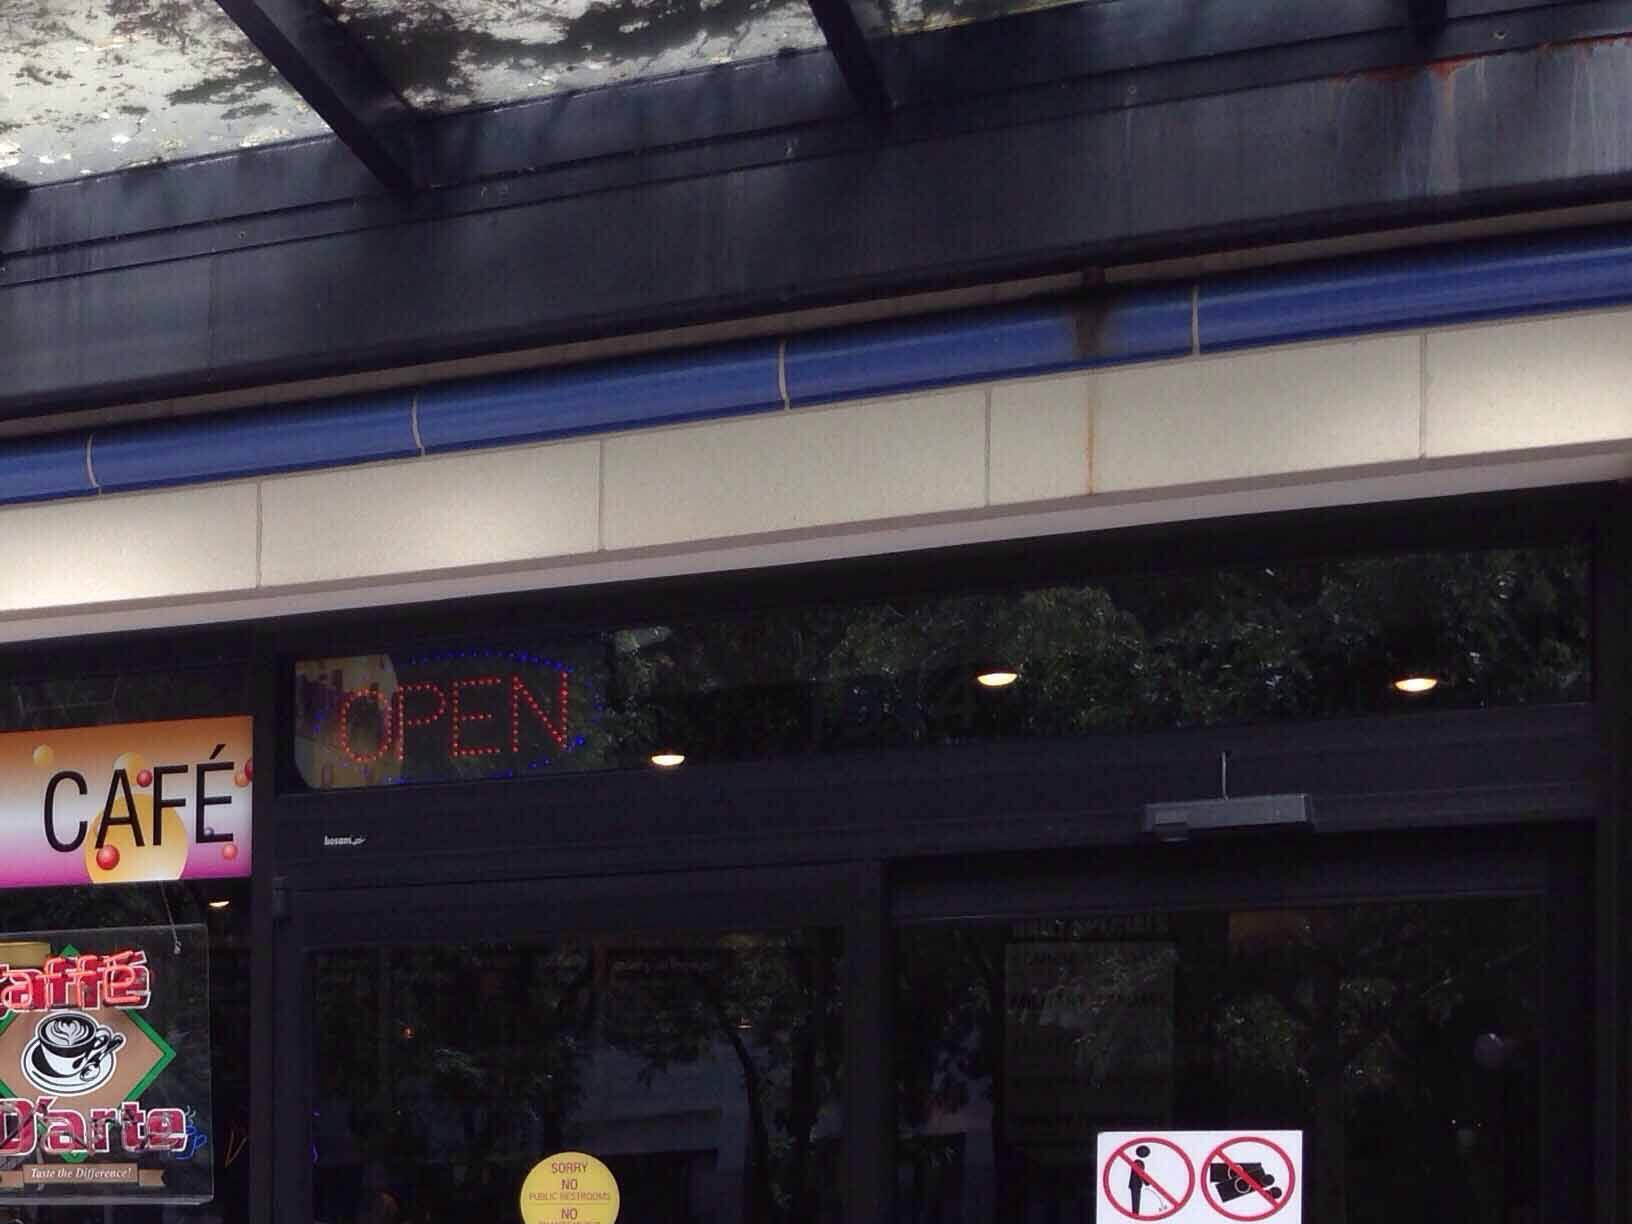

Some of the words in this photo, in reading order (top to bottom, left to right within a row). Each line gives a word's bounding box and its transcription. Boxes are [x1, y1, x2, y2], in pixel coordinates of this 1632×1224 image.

[339, 670, 569, 763] OPEN
[44, 743, 235, 853] CAFÉ
[31, 1167, 55, 1178] Taste
[57, 1167, 73, 1178] the
[75, 1167, 132, 1180] Difference!
[551, 1162, 587, 1174] SORRY
[561, 1179, 578, 1190] NO
[529, 1192, 557, 1201] PUBLIC
[560, 1192, 610, 1201] RESTROOMS
[561, 1208, 578, 1220] NO
